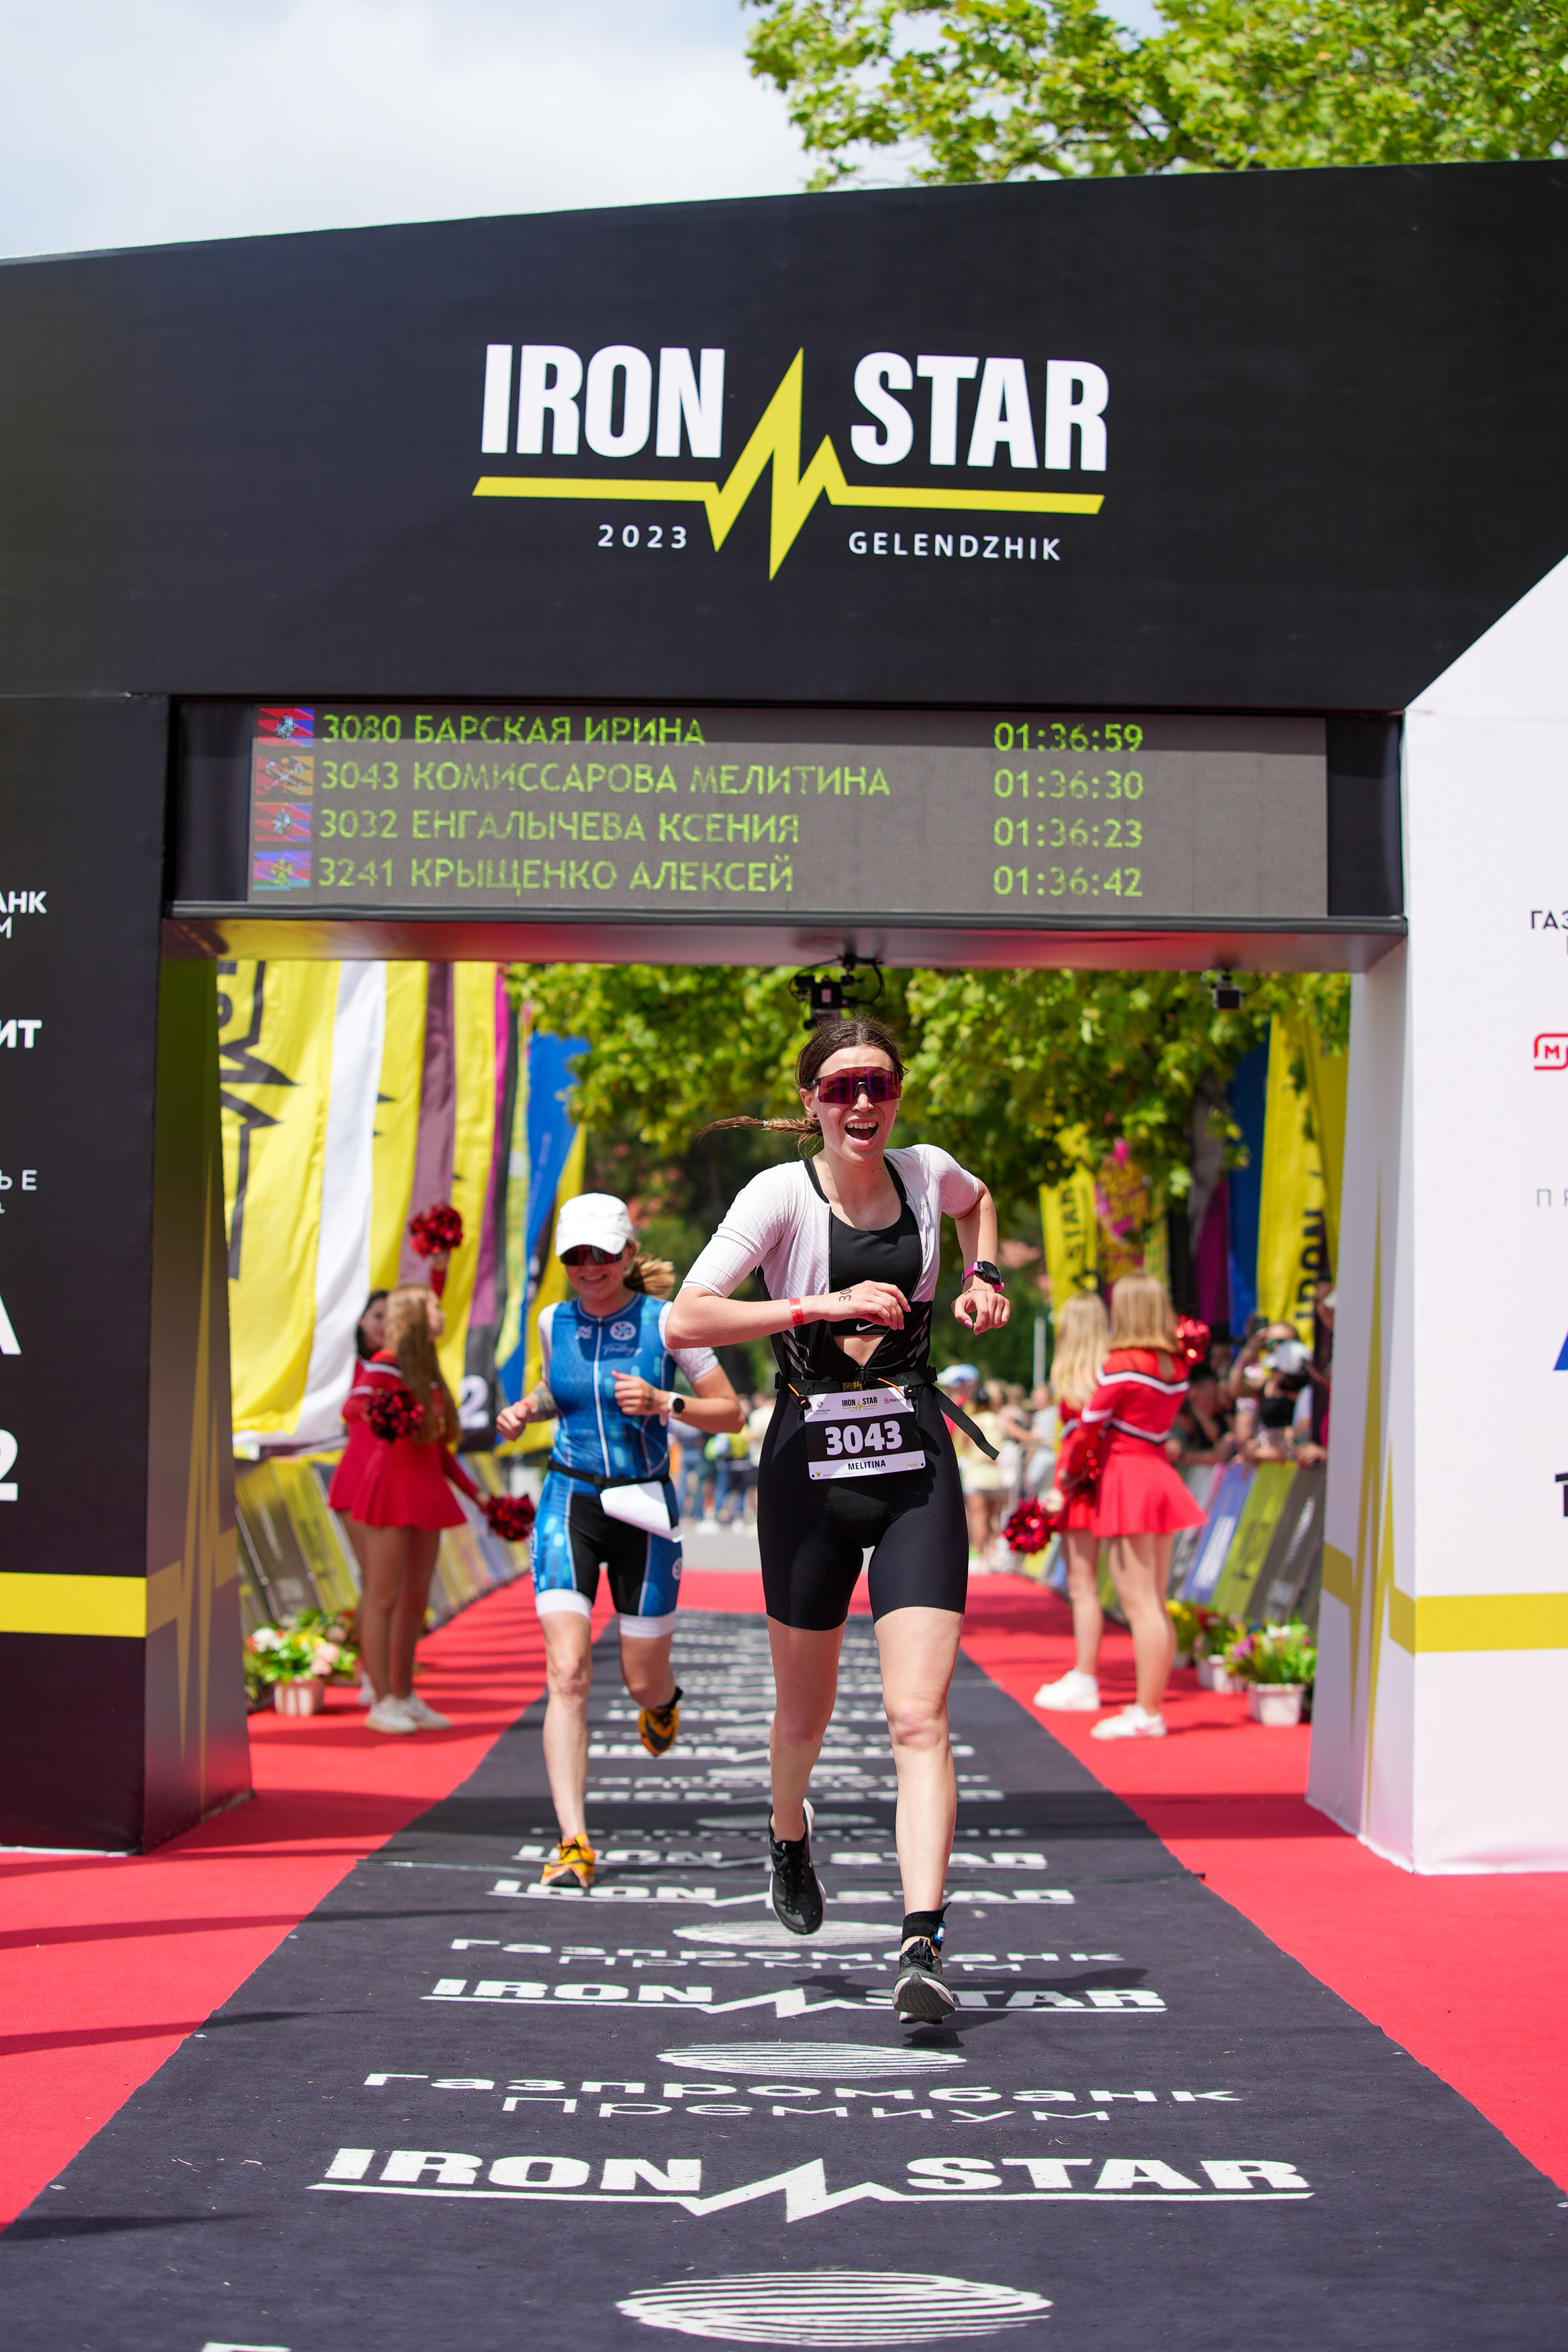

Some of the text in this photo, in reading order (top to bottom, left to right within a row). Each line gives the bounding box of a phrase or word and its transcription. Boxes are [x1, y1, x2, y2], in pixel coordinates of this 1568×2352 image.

[481, 344, 1109, 472] IRON STAR
[597, 524, 1061, 561] 2023 GELENDZHIK
[323, 713, 1143, 752] 3080 БАРСКАЯ ИРИНА 01:36:59
[322, 761, 1143, 800] 3043 КОМИССАРОВА МЕЛИТИНА 01:36:30
[321, 808, 1142, 848] 3032 ЕНГАЛЫЧЕВА КСЕНИЯ 01:36:23
[319, 854, 1142, 897] 3241 КРЫЩЕНКО АЛЕКСЕЙ 01:36:42
[842, 1396, 878, 1407] IRON STAR
[825, 1420, 903, 1456] 3043
[848, 1459, 886, 1471] MELITINA
[830, 1851, 1046, 1867] SAR
[837, 1889, 1075, 1902] SAR
[558, 1955, 1021, 1972] Премим
[431, 1978, 713, 2003] IRON
[363, 2072, 1242, 2102] Газпромбанк
[502, 2096, 1110, 2123] Премиум
[324, 2148, 1312, 2192] IRON STAR
